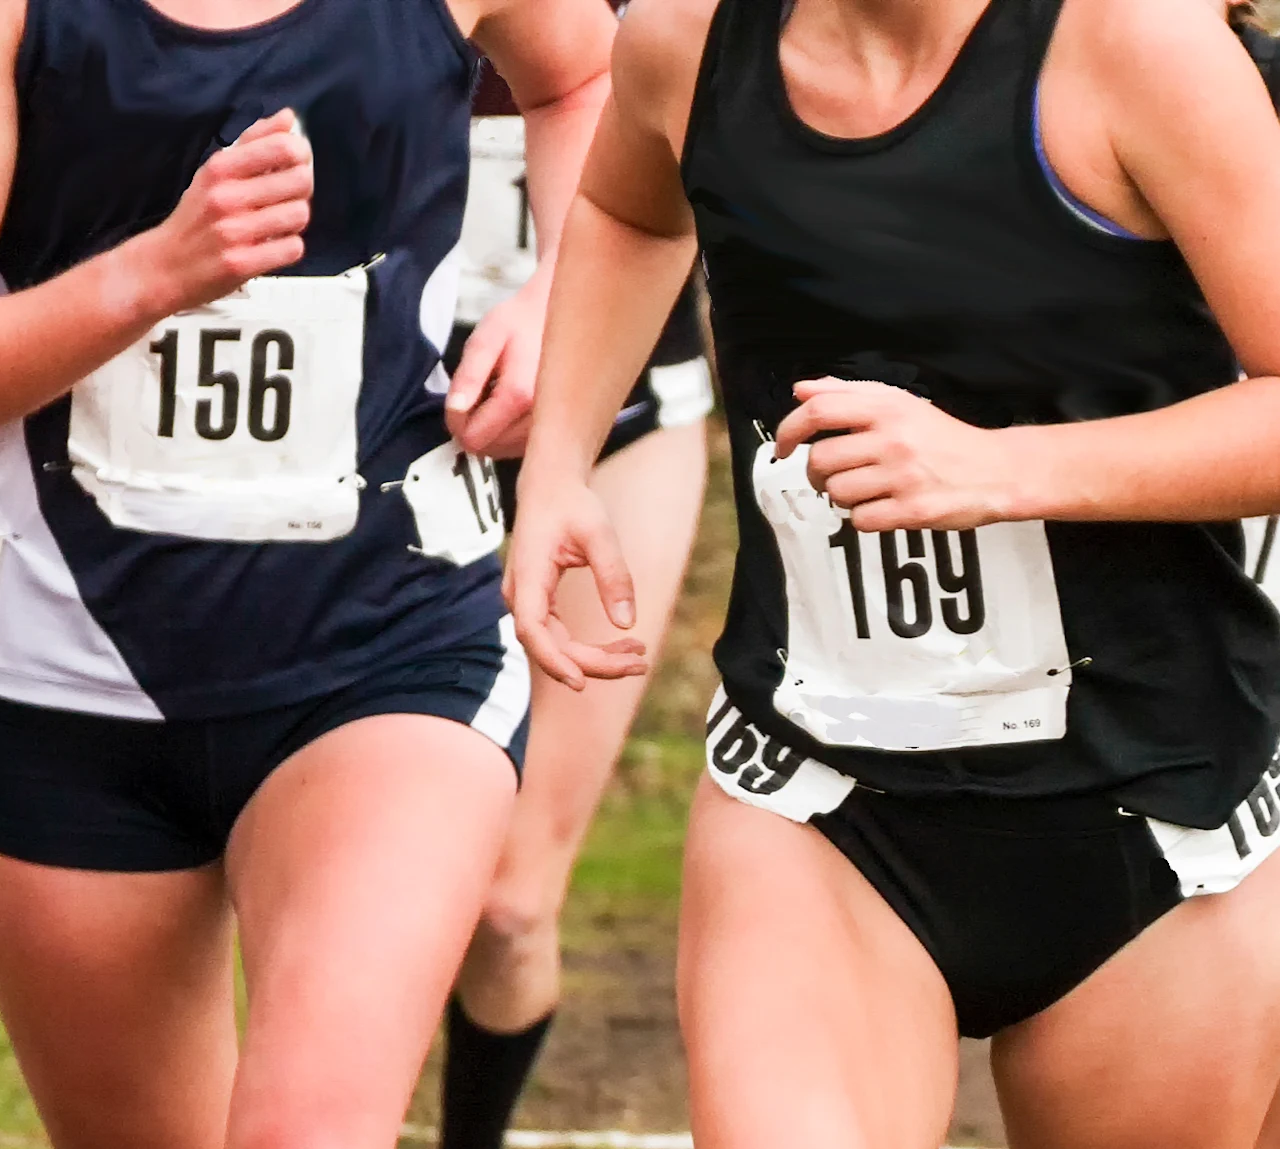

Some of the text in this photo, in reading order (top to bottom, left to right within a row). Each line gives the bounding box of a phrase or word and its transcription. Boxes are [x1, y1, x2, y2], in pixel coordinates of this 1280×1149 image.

[149, 328, 294, 441] 156
[828, 518, 986, 639] 169
[1003, 719, 1041, 730] No. 169
